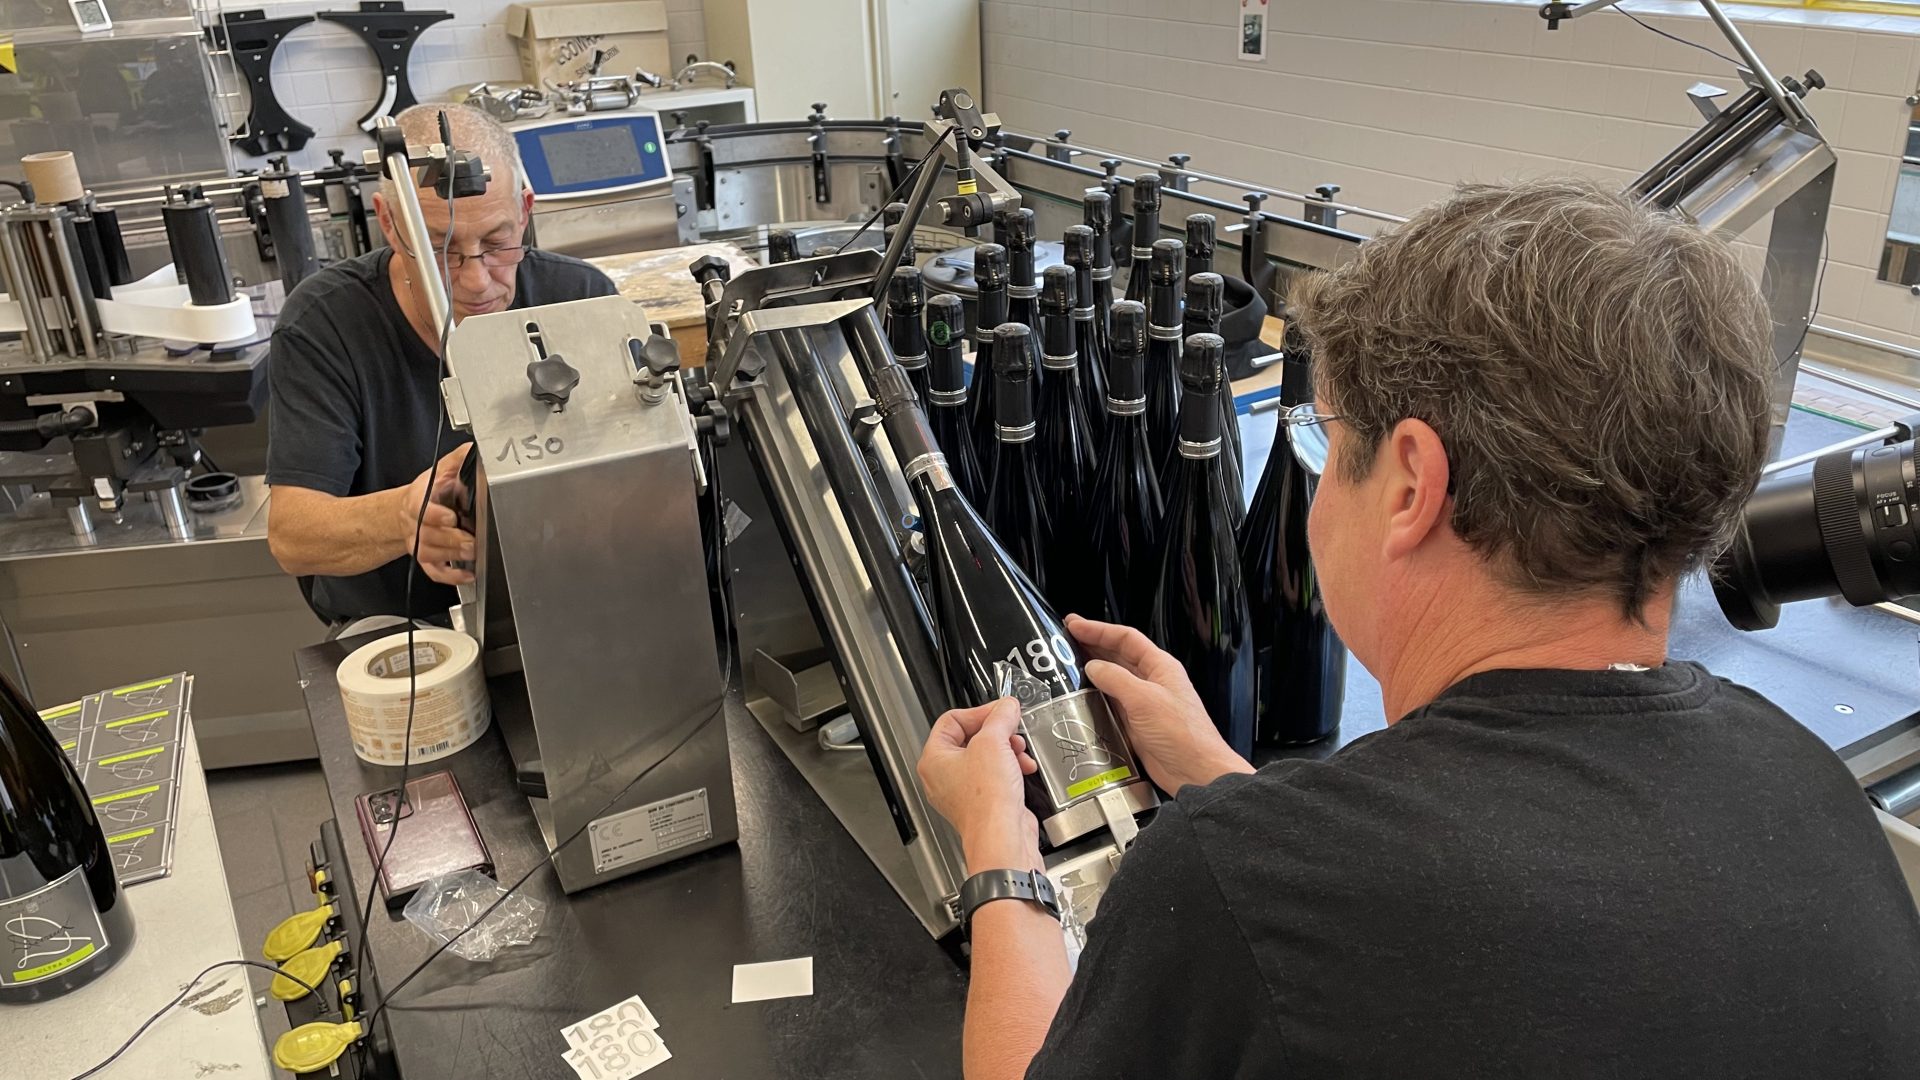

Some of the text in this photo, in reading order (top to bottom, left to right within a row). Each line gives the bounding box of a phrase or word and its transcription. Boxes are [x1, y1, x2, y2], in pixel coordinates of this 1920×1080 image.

[496, 434, 564, 465] 150
[1876, 491, 1897, 499] FOCUS
[1006, 634, 1076, 679] 180
[577, 1030, 657, 1080] 180
